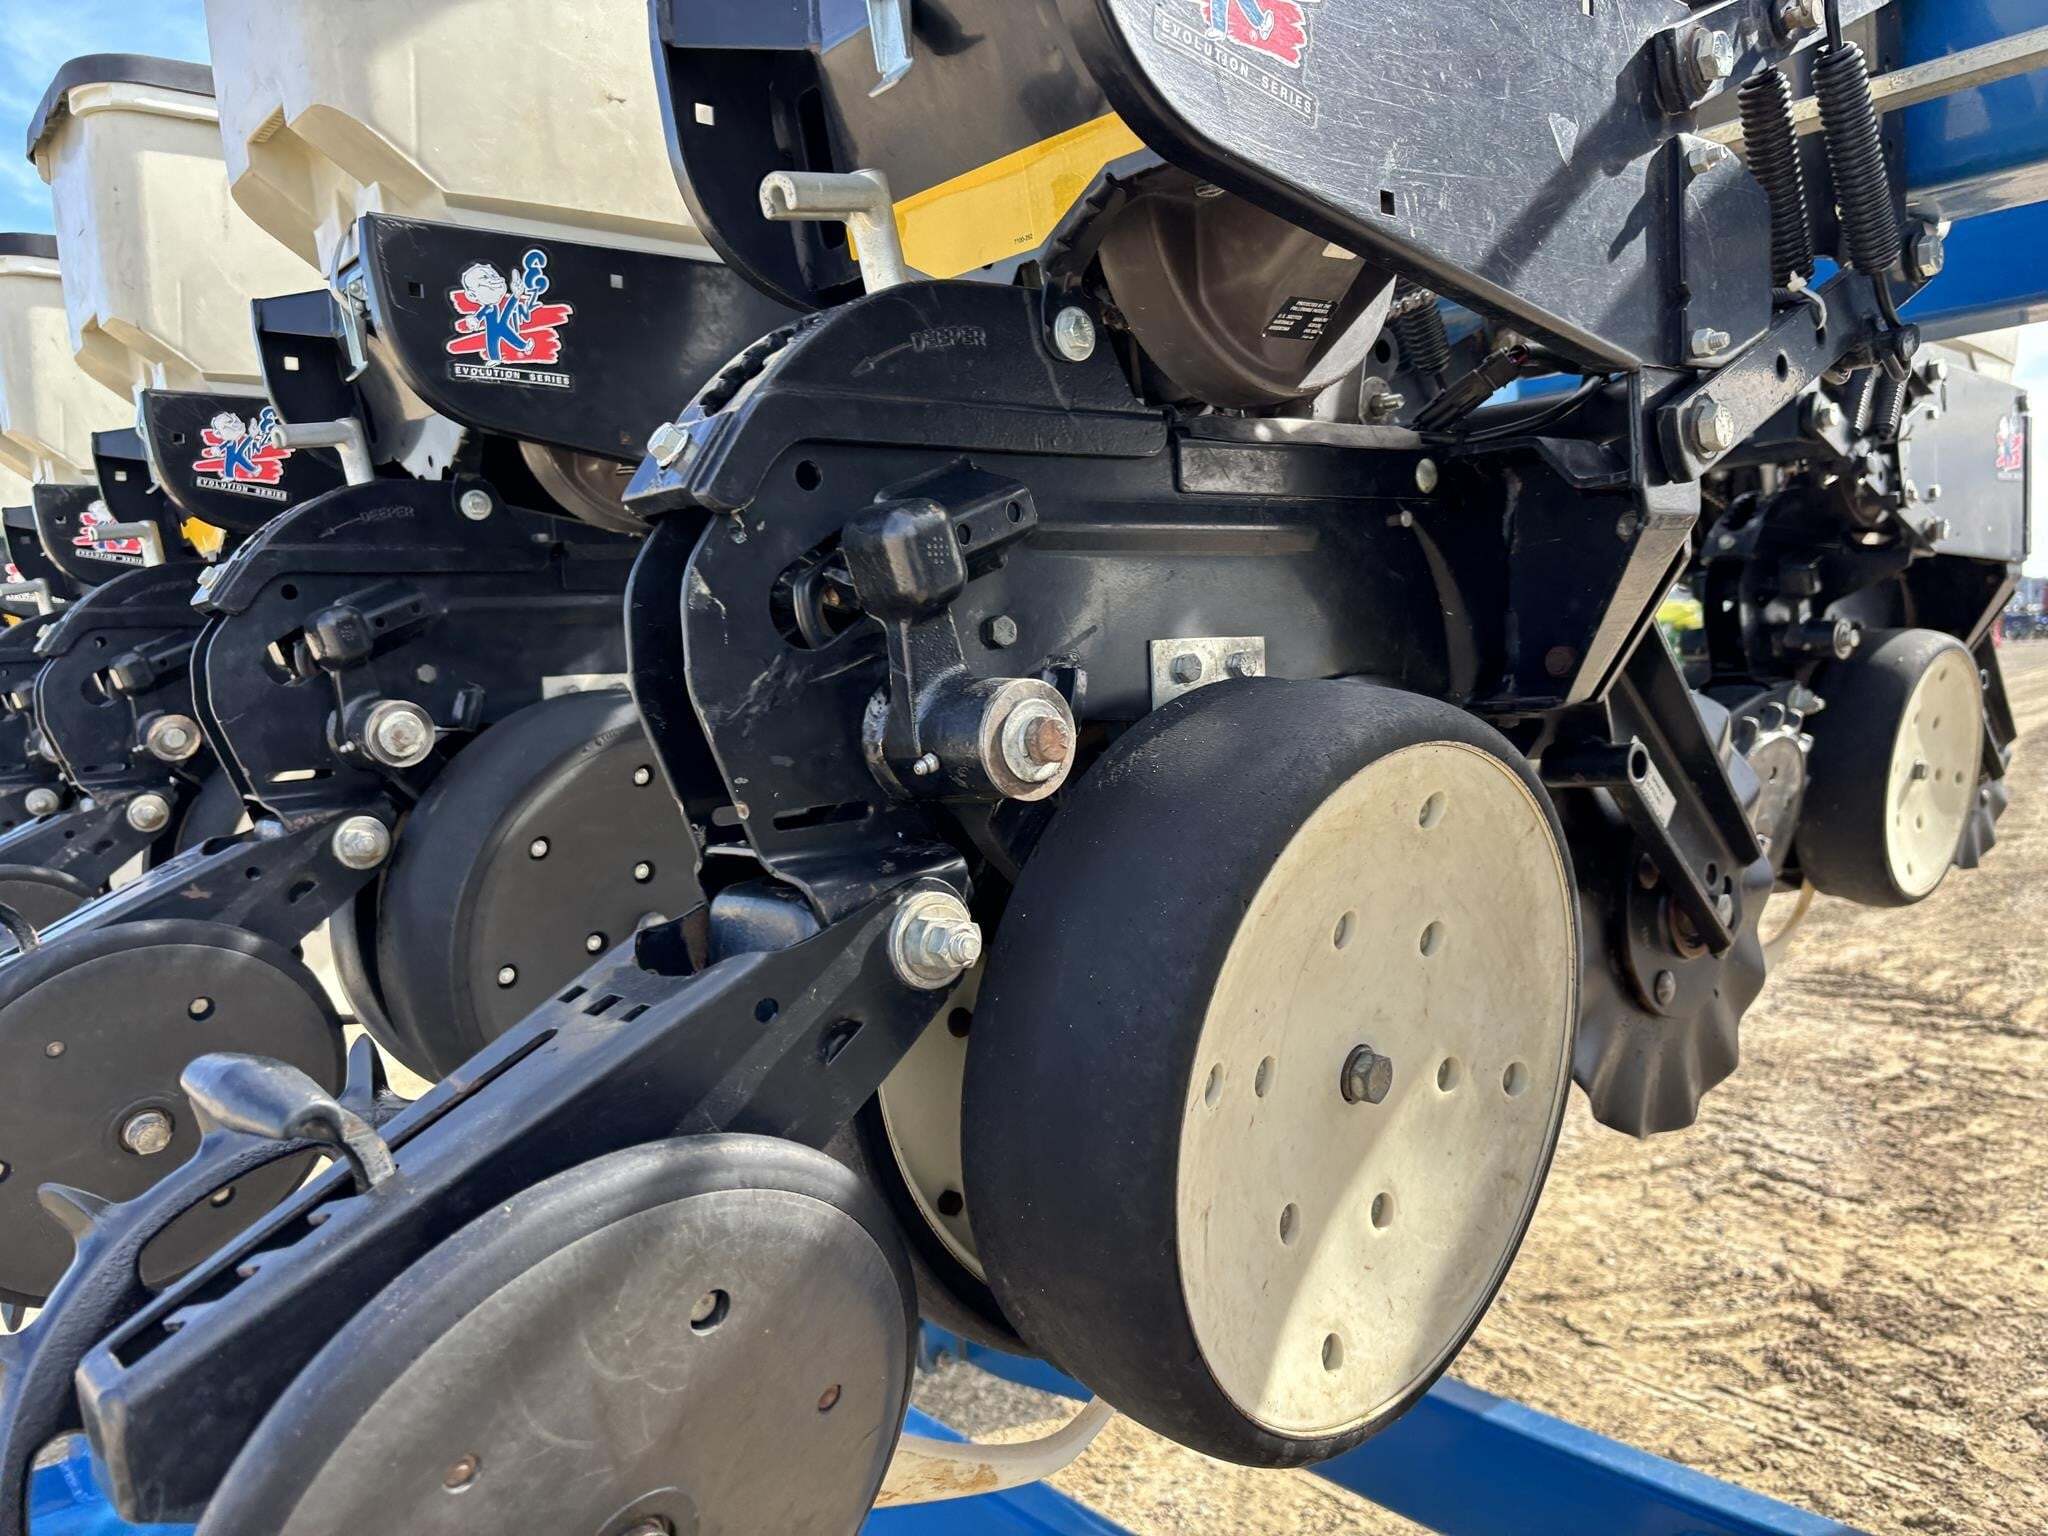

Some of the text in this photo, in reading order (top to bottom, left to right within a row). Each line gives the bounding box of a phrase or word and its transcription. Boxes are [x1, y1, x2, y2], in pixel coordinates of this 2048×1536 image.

[1161, 17, 1250, 78] EVOLUTION
[1260, 74, 1312, 114] SERIES
[454, 366, 571, 385] EVOLUTION SERIES
